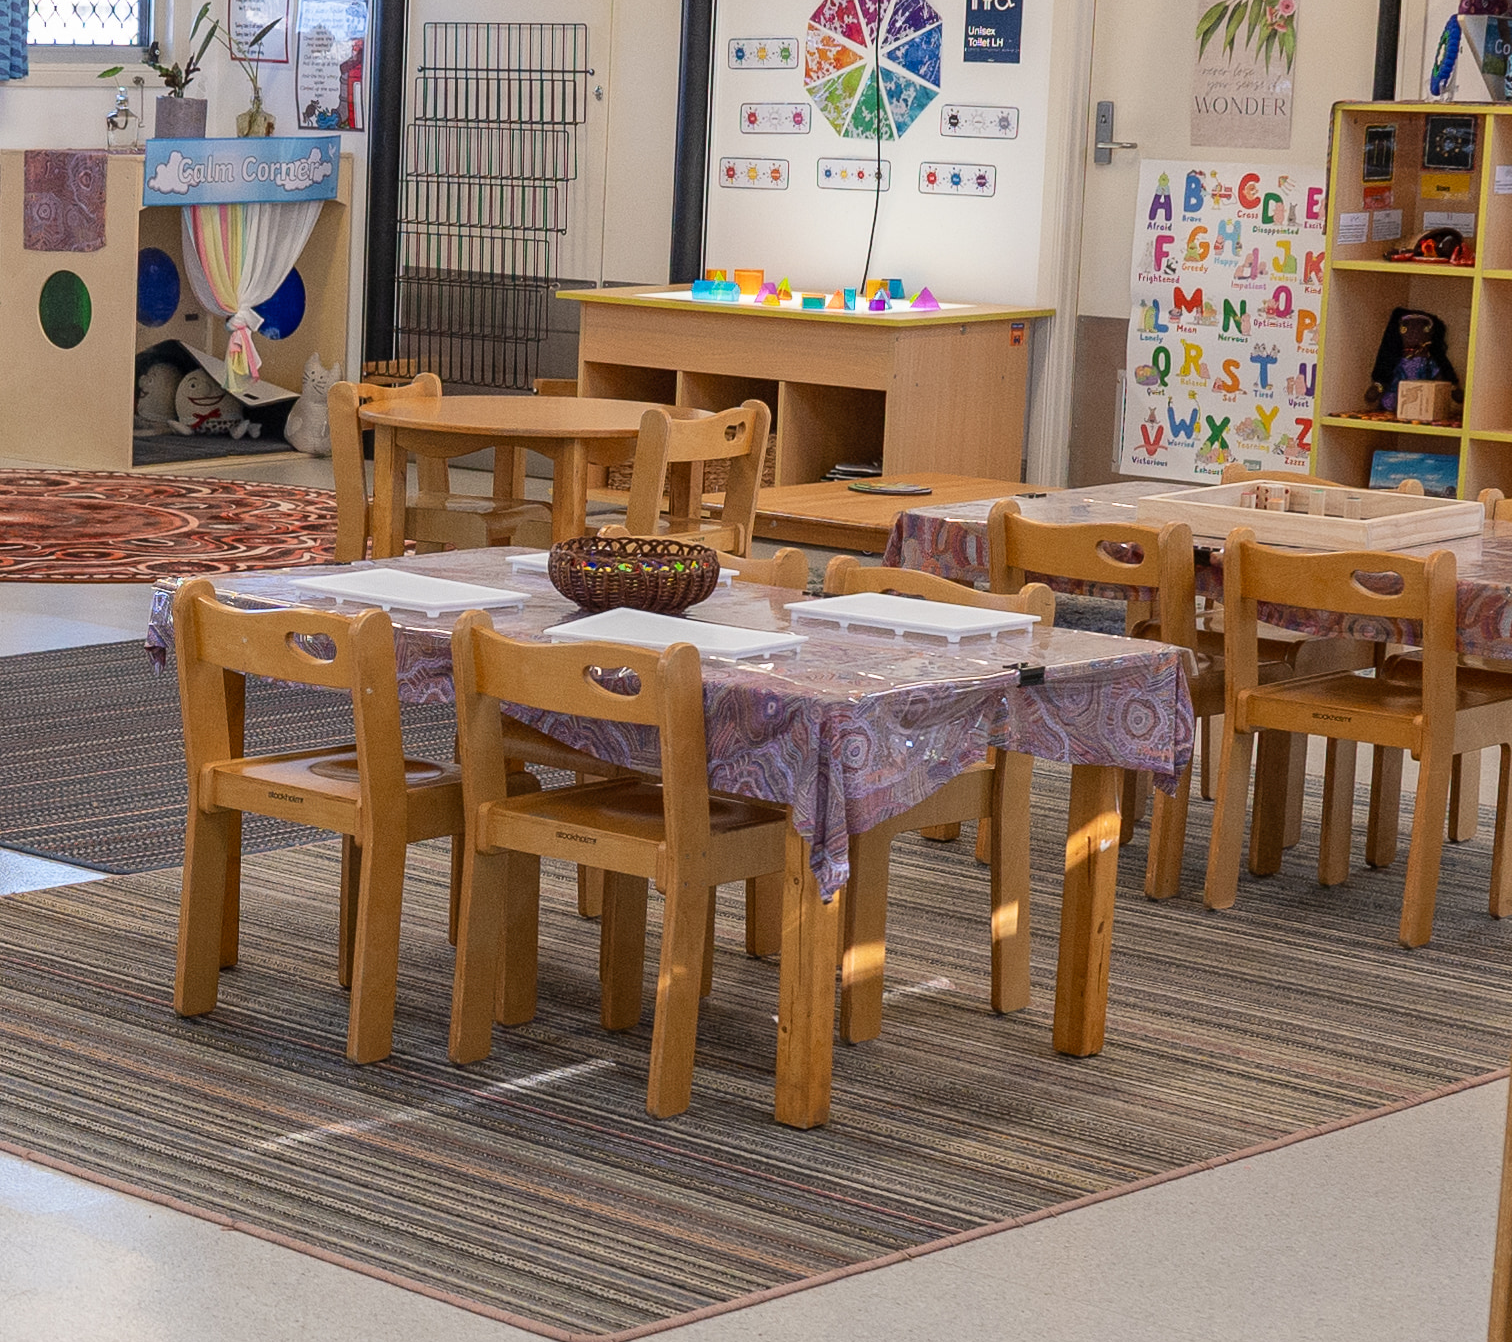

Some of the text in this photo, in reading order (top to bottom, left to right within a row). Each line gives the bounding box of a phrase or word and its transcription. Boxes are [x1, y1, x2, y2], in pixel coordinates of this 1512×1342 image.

[968, 26, 996, 36] Unisex
[968, 37, 1004, 47] Toilet LH
[1195, 95, 1287, 116] WONDER
[178, 155, 321, 184] Calm Corner
[1237, 210, 1259, 219] Cross
[1147, 223, 1173, 232] Afraid
[1252, 226, 1300, 235] Disappointed
[1181, 264, 1208, 274] Greedy
[1138, 273, 1181, 284] Frightened
[1231, 281, 1267, 291] Impatient
[1253, 319, 1294, 329] Optimistic
[1176, 325, 1197, 334] Mean
[1139, 333, 1164, 344] Lonely
[1218, 333, 1249, 343] Nervous
[1222, 394, 1237, 402] Sad
[1253, 389, 1274, 398] Tired
[1288, 399, 1310, 408] Upset
[1131, 456, 1168, 467] Victorious
